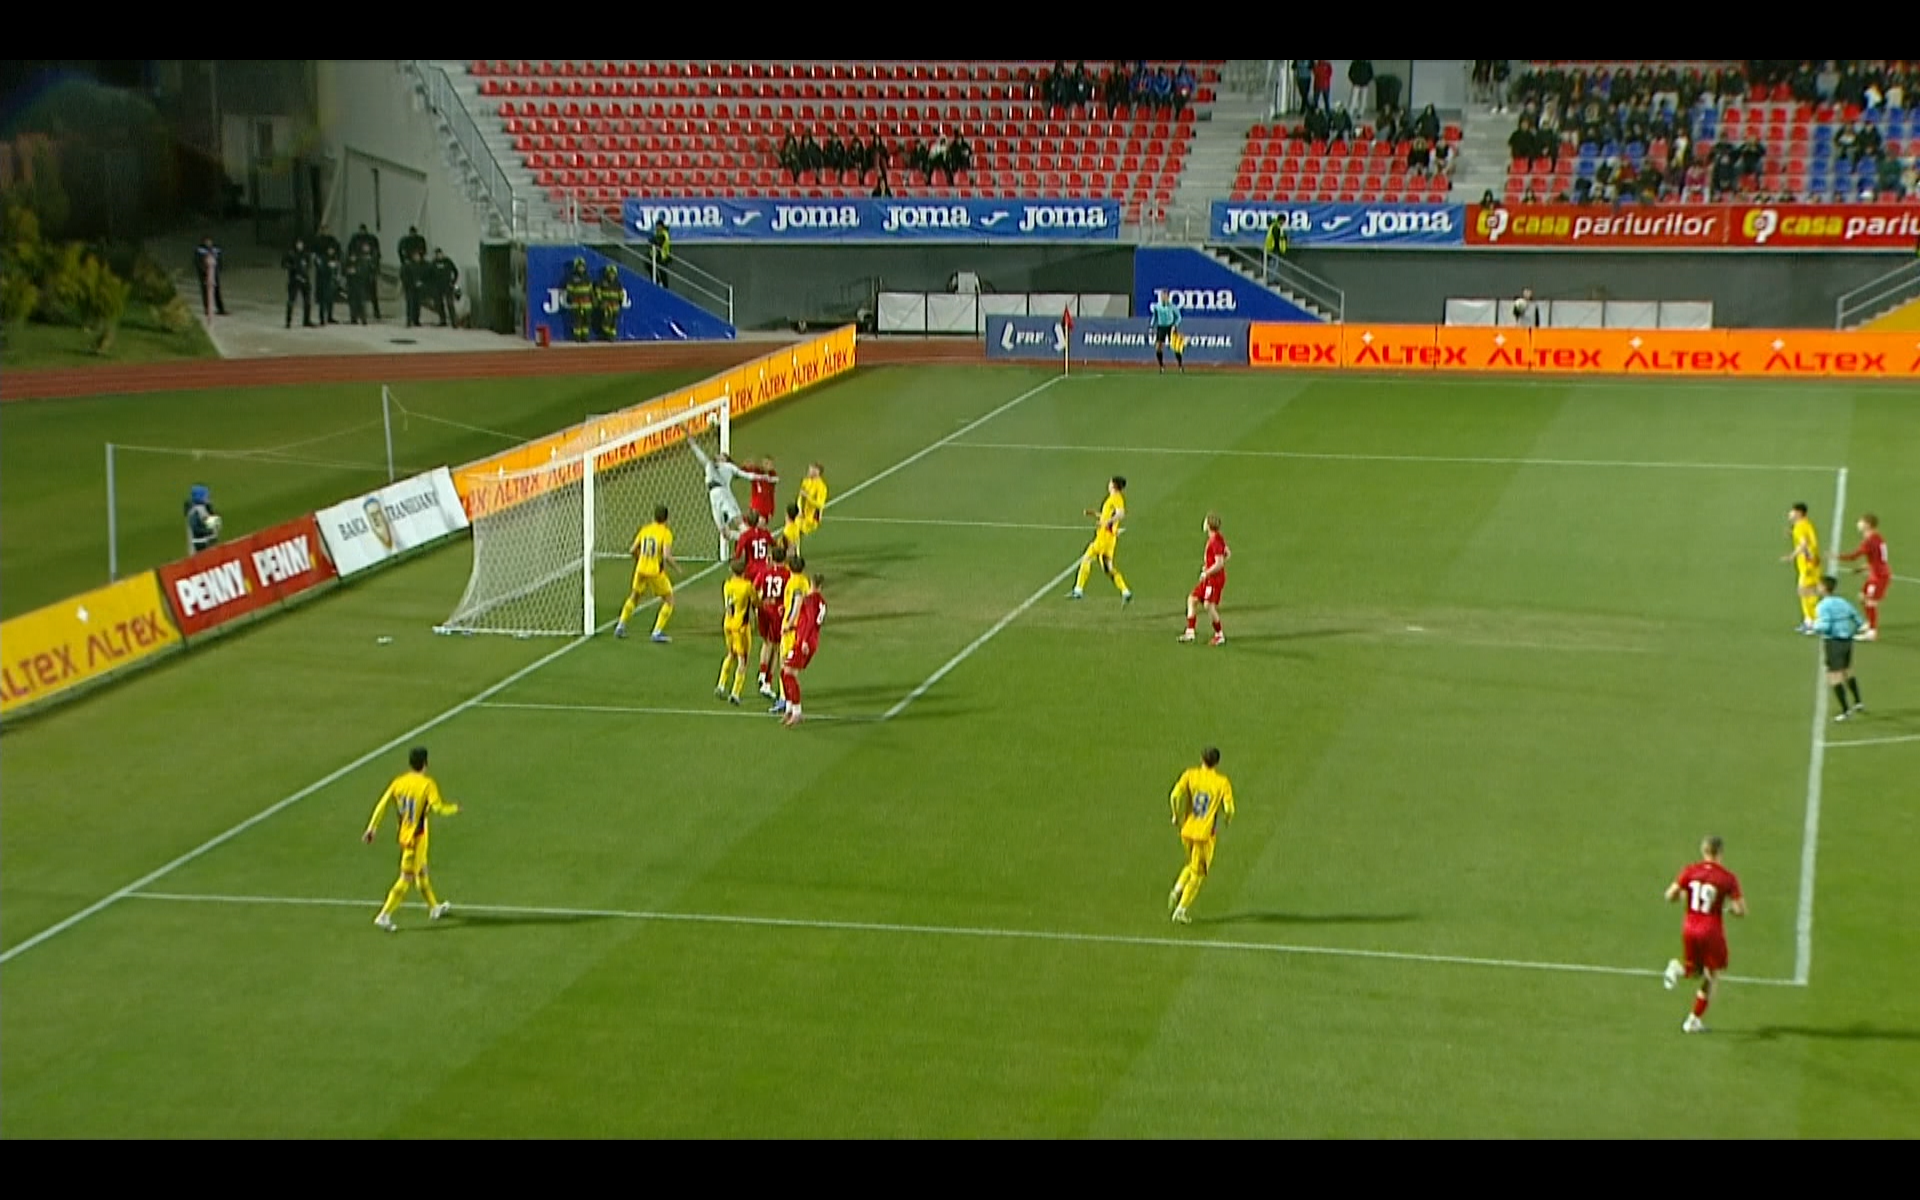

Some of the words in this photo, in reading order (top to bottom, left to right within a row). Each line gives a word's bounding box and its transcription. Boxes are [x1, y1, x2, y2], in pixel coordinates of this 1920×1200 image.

[1512, 214, 1570, 236] casa
[1573, 211, 1716, 239] pariurilor
[1780, 214, 1844, 236] casa
[752, 538, 767, 559] 15
[765, 574, 783, 598] 13
[1688, 880, 1717, 914] 19
